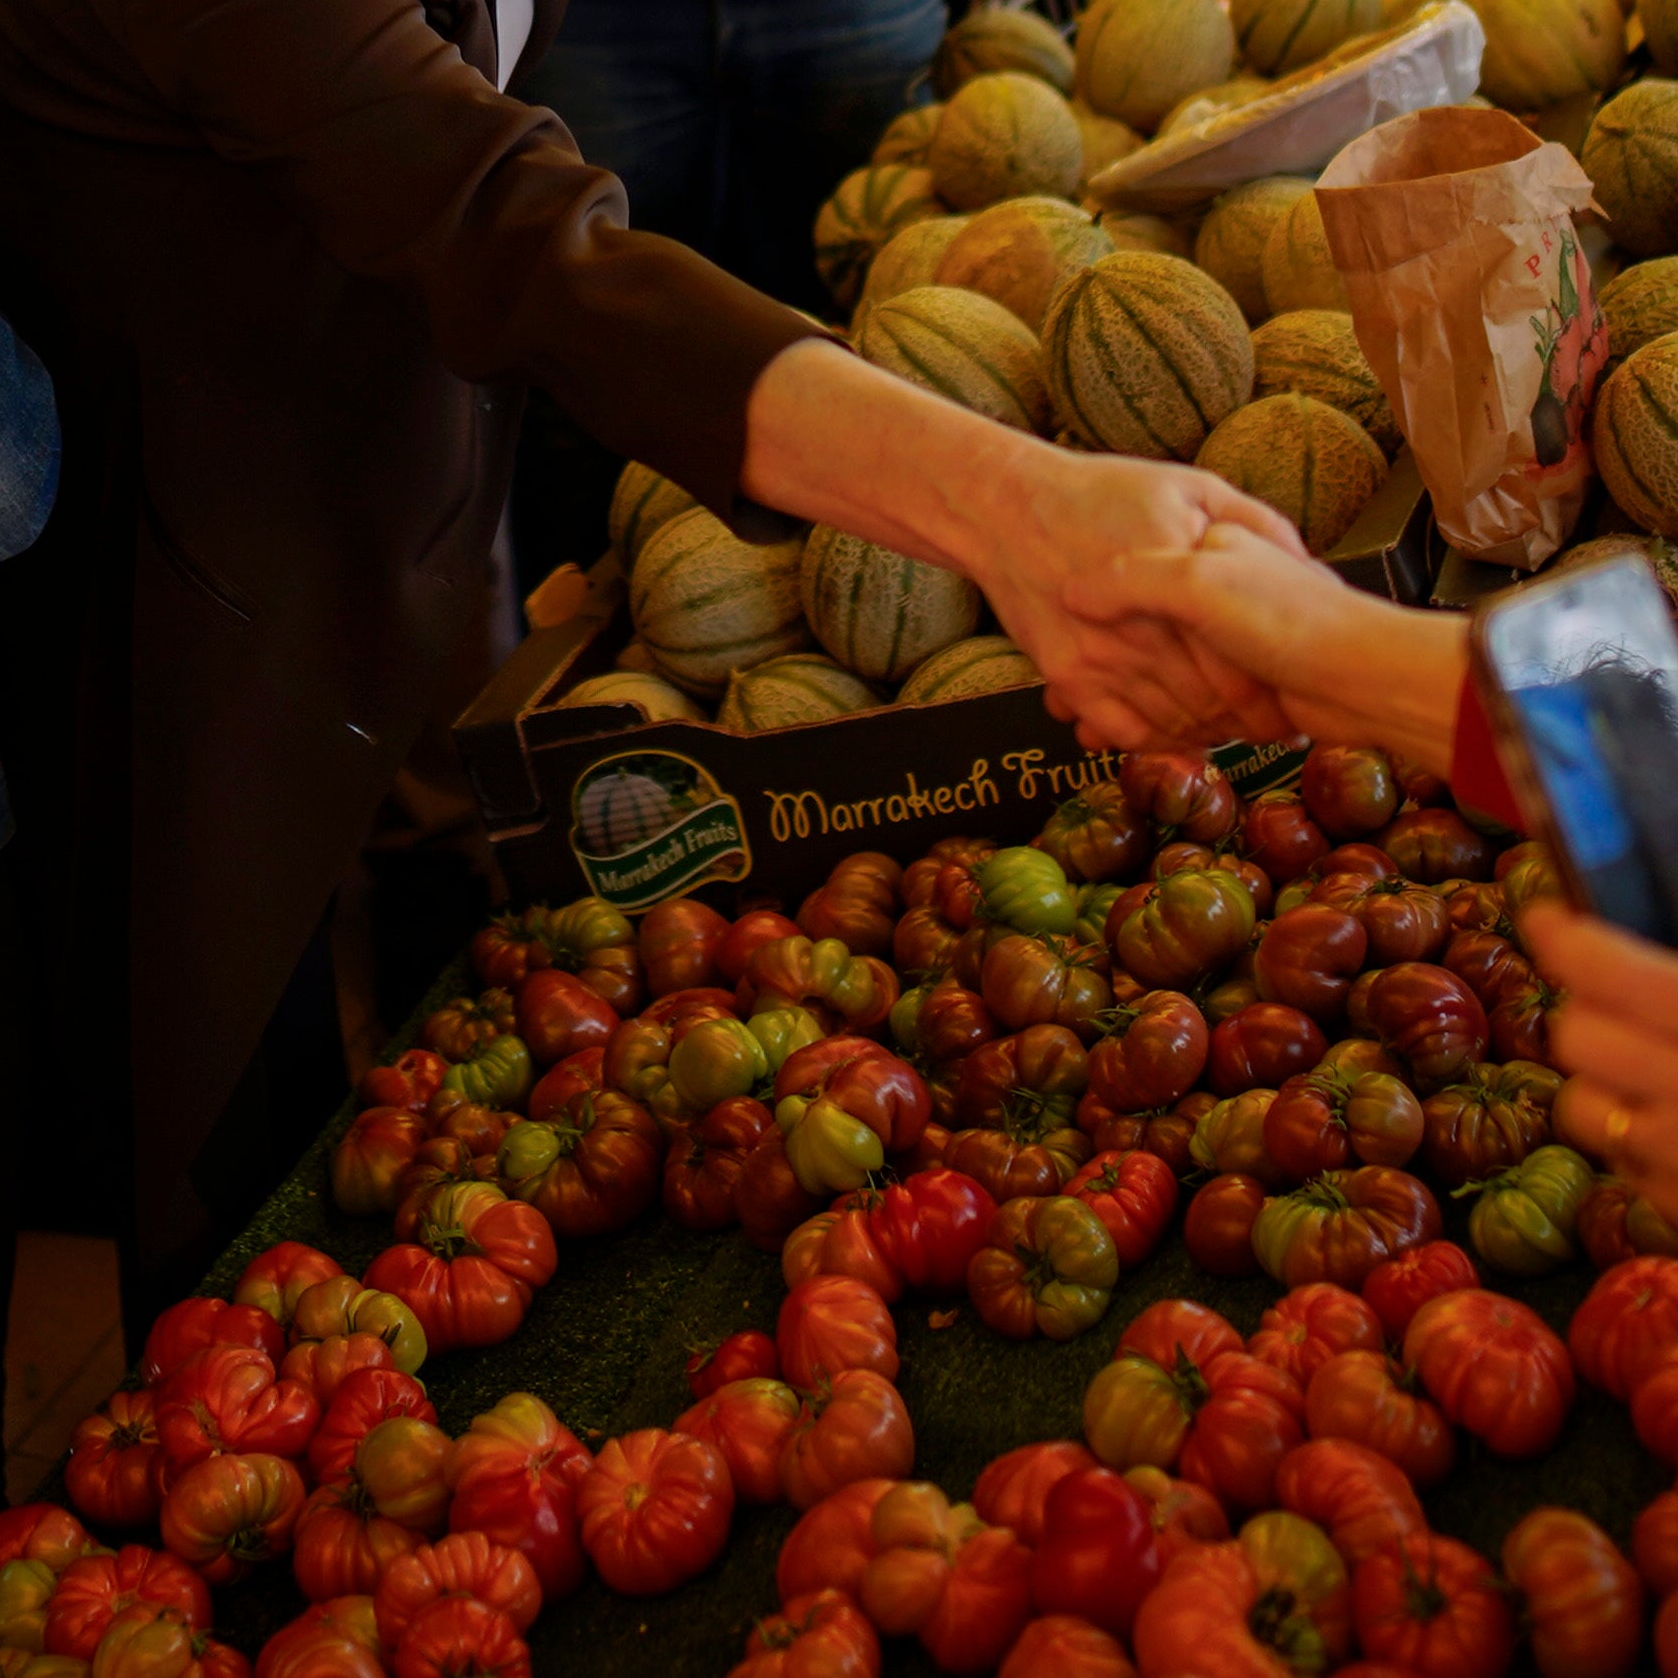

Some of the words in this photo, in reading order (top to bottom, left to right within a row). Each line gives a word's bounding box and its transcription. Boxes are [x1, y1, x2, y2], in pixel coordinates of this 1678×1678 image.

[763, 758, 1001, 843] Marrakech
[597, 838, 687, 892] Marrakech
[683, 820, 739, 855] Fruits
